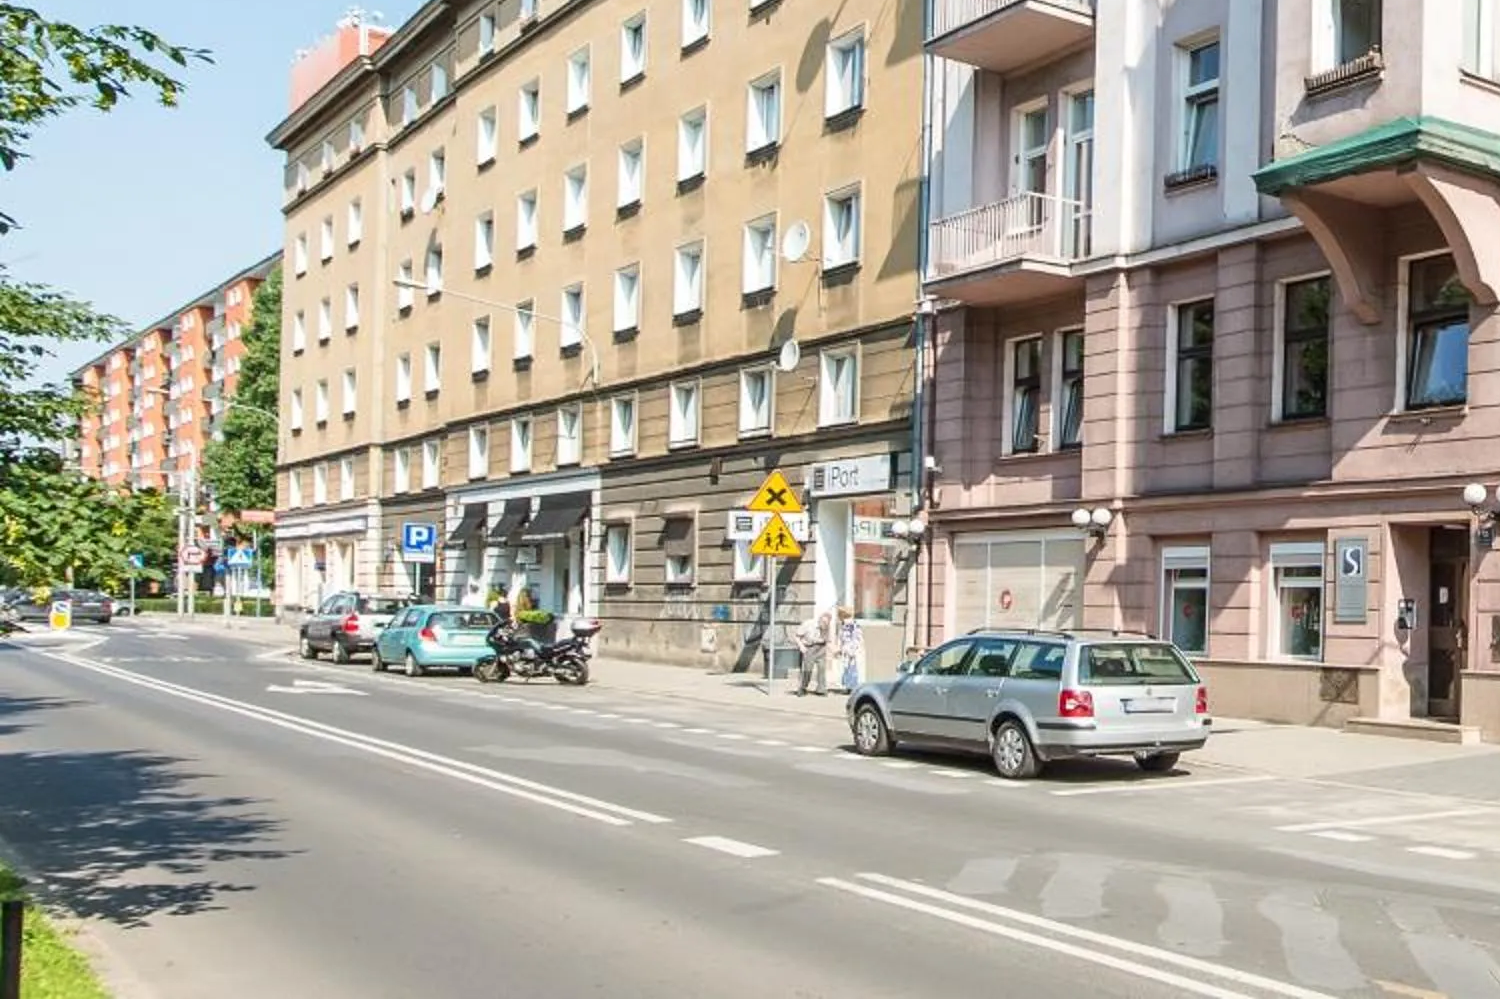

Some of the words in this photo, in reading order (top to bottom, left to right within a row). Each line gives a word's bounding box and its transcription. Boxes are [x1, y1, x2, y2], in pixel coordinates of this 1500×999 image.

[827, 465, 860, 489] iPort
[759, 516, 804, 533] irt
[409, 526, 430, 546] P
